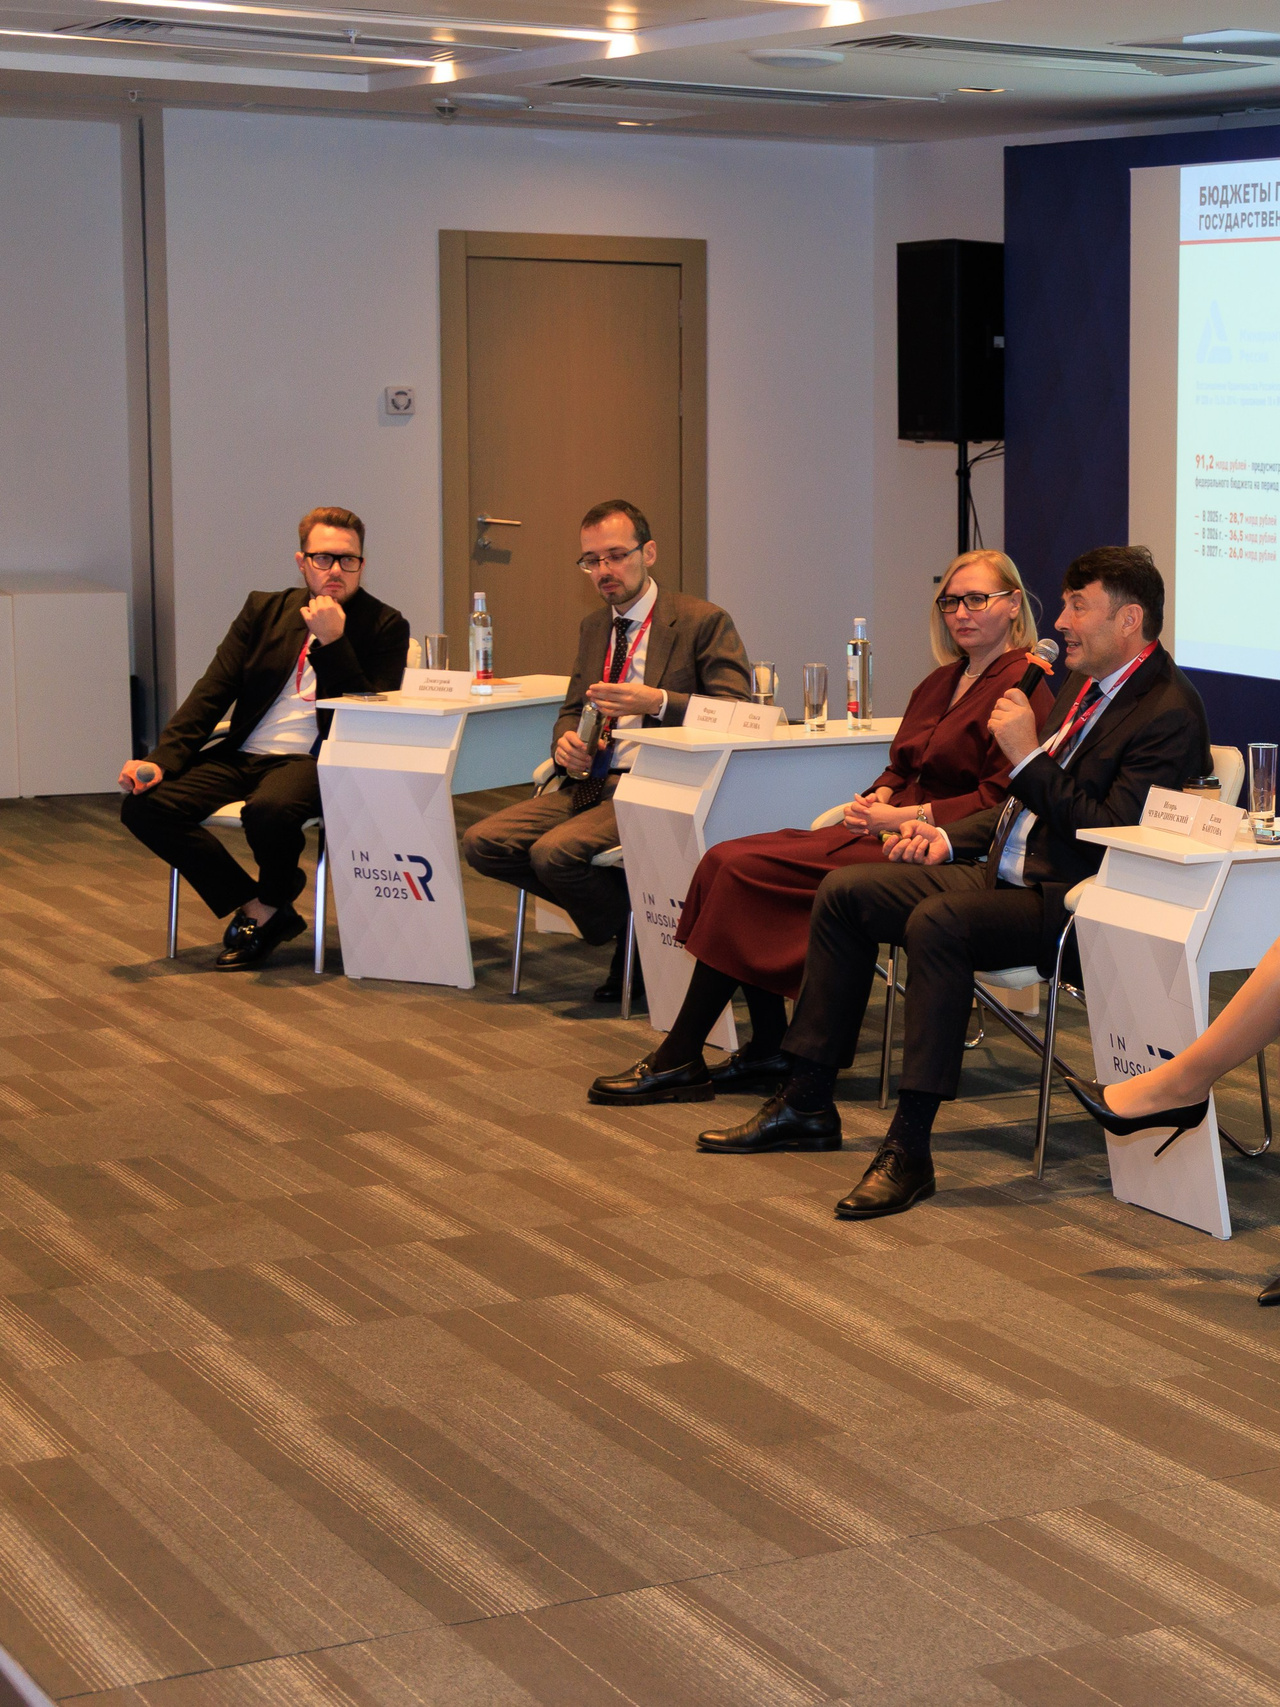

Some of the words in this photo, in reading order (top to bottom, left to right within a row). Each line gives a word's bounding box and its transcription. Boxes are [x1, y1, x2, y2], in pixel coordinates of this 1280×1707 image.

[1199, 181, 1271, 208] БЮДЖЕТЫ
[1195, 454, 1214, 471] 91,2
[351, 850, 369, 862] IN
[354, 867, 401, 882] RUSSIA
[374, 886, 408, 900] 2025
[642, 892, 655, 905] IN
[646, 911, 677, 929] RUSSIA
[1109, 1033, 1126, 1052] IN
